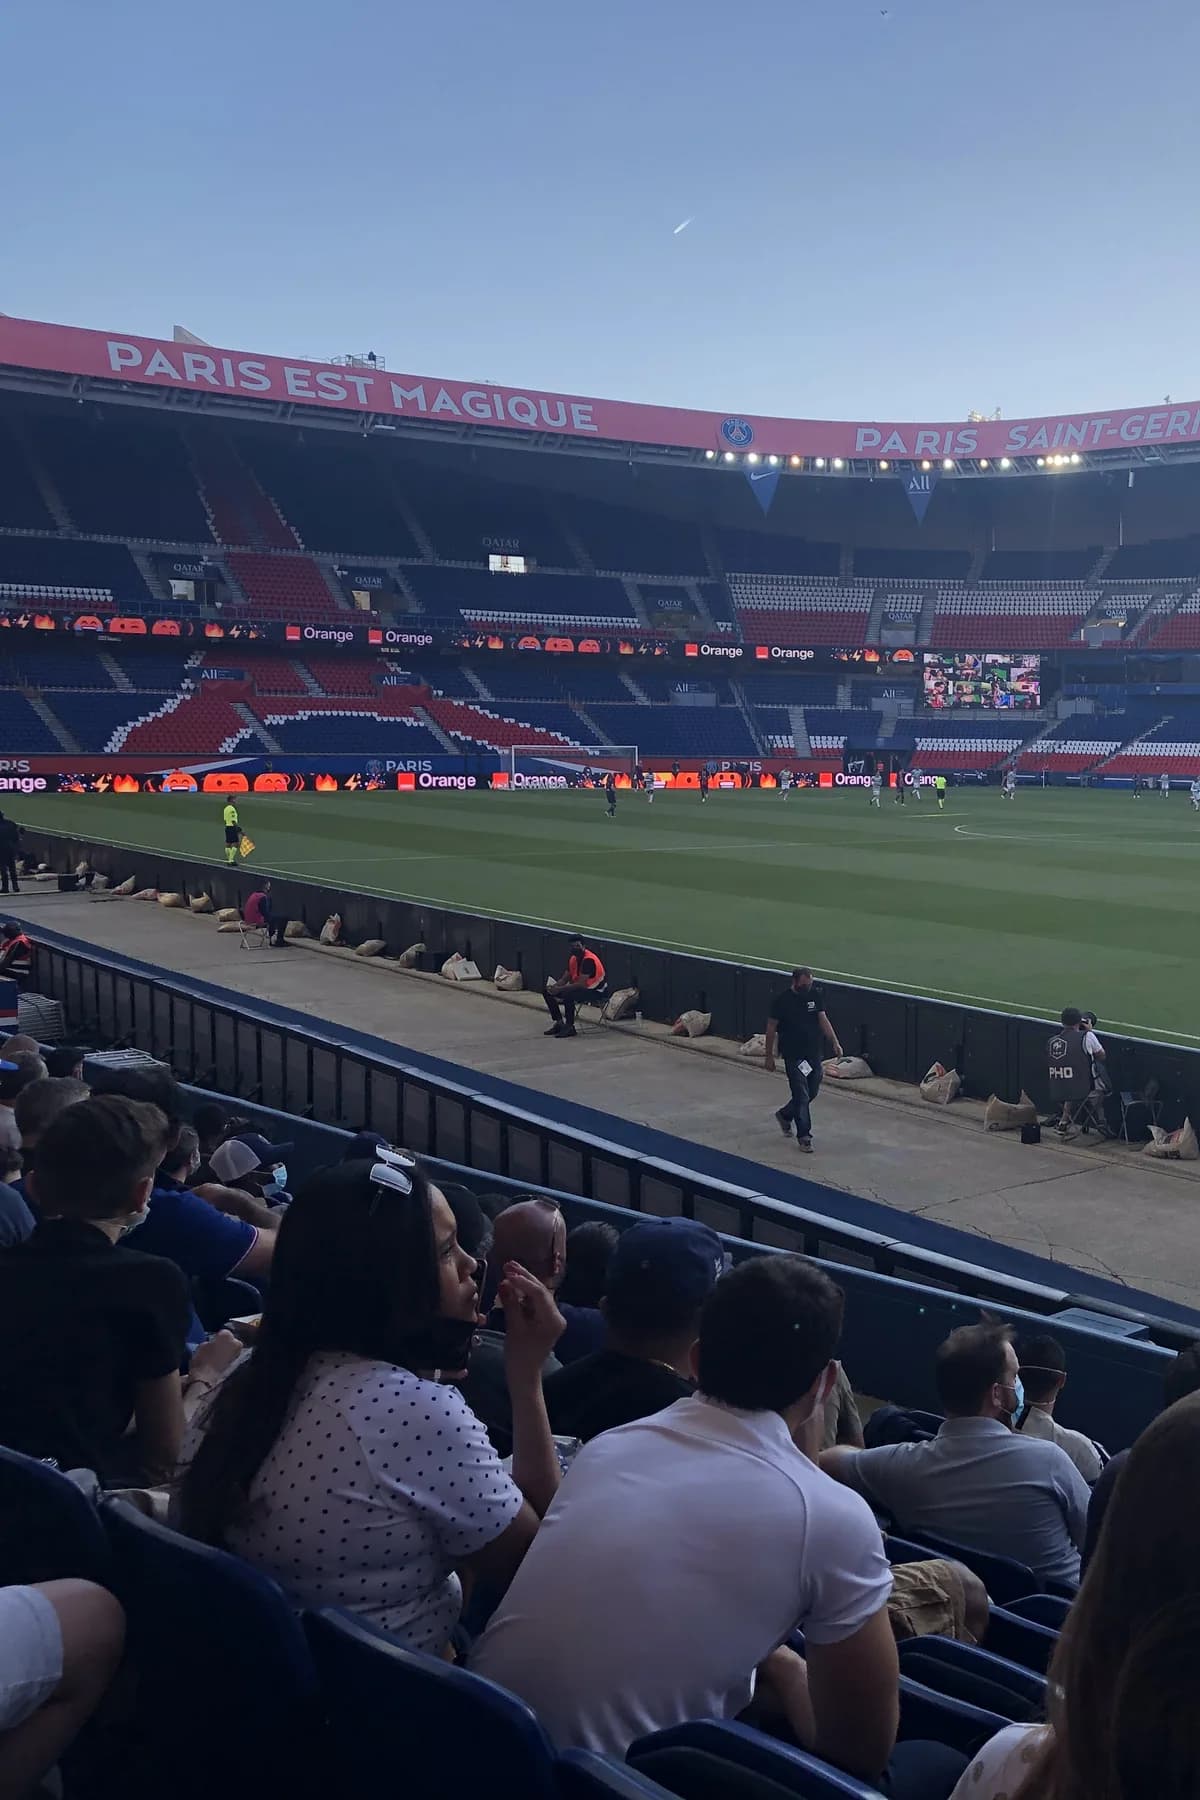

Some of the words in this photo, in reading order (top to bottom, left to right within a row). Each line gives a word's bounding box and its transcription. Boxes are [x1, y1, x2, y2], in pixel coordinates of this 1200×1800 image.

[106, 340, 273, 392] PARIS
[283, 366, 374, 405] EST
[390, 380, 599, 433] MAGIQUE
[855, 427, 979, 456] PARIS
[355, 576, 383, 586] QATAR
[888, 612, 914, 622] QATAR
[303, 626, 354, 643] Orange
[385, 631, 433, 646] Orange
[701, 645, 743, 657] Orange
[771, 647, 814, 661] Orange
[386, 760, 432, 771] PARIS
[418, 774, 476, 789] Orange
[835, 773, 873, 787] Orang
